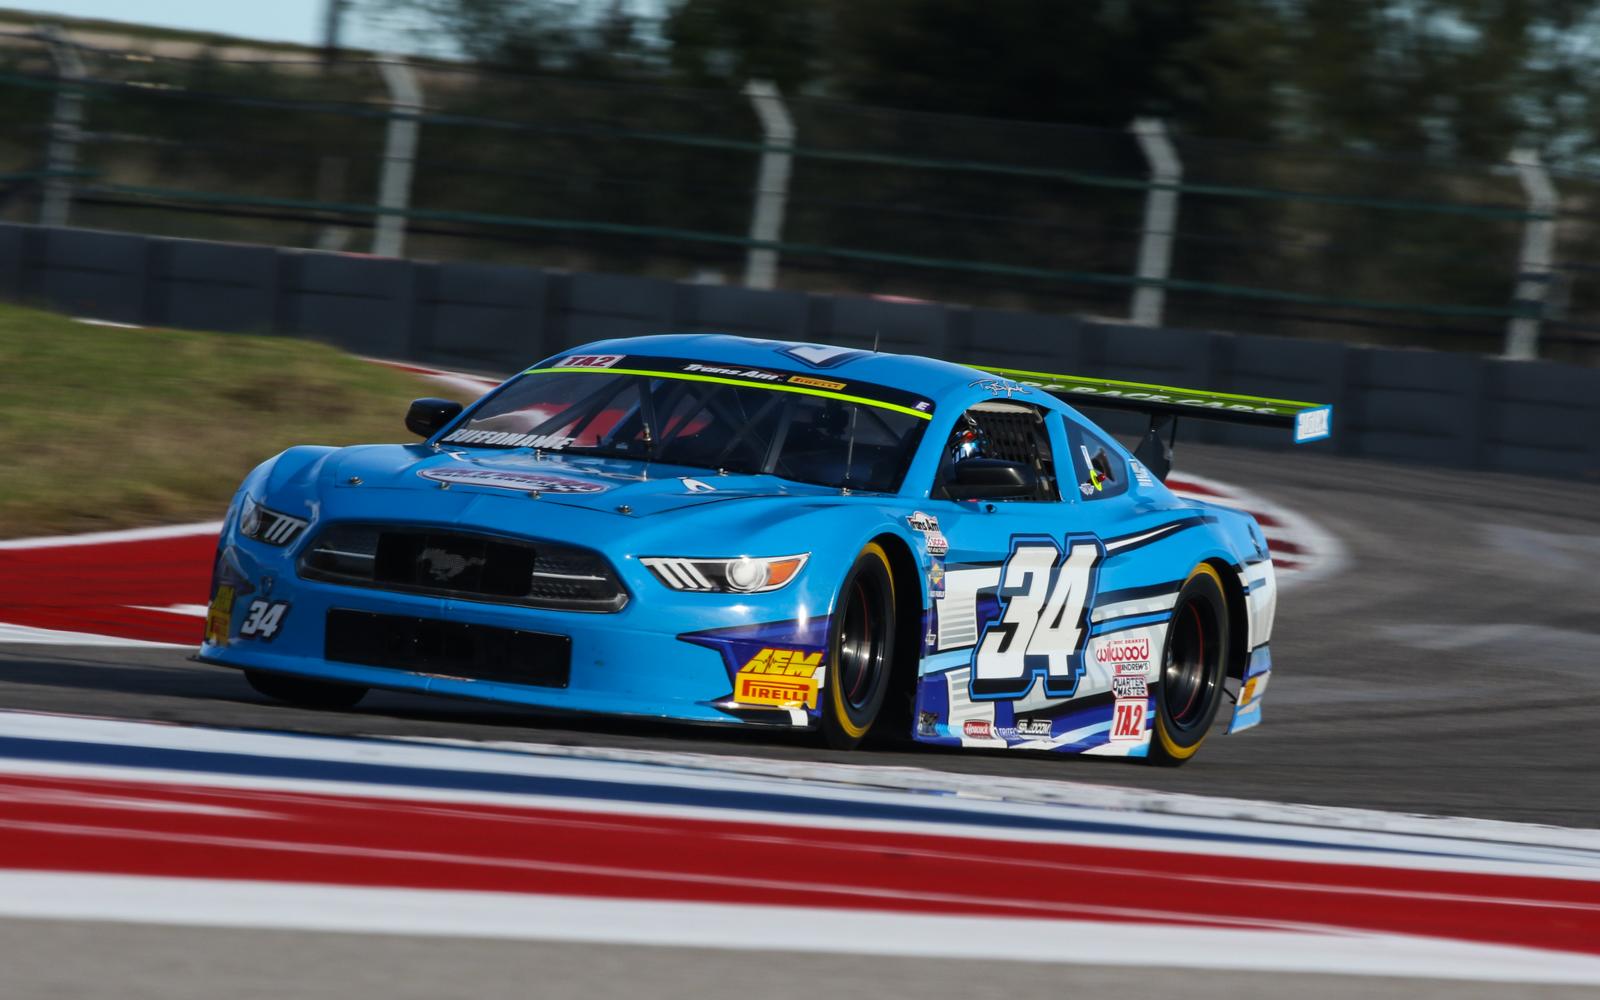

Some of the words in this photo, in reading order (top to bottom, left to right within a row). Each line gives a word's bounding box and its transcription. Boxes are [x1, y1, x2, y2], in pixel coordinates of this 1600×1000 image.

[564, 356, 615, 367] TA2
[683, 364, 739, 377] Trans
[740, 367, 779, 381] Am
[793, 377, 840, 390] PIRELLI
[1070, 386, 1171, 402] RACE
[914, 401, 929, 410] E
[240, 600, 288, 638] 34
[975, 541, 1100, 683] 34
[1096, 638, 1149, 662] wilwood
[739, 647, 824, 679] AEM
[742, 679, 811, 702] PIRELLI
[1113, 677, 1145, 691] QUARTER
[1117, 686, 1147, 697] MASTER
[1114, 704, 1143, 736] TA2
